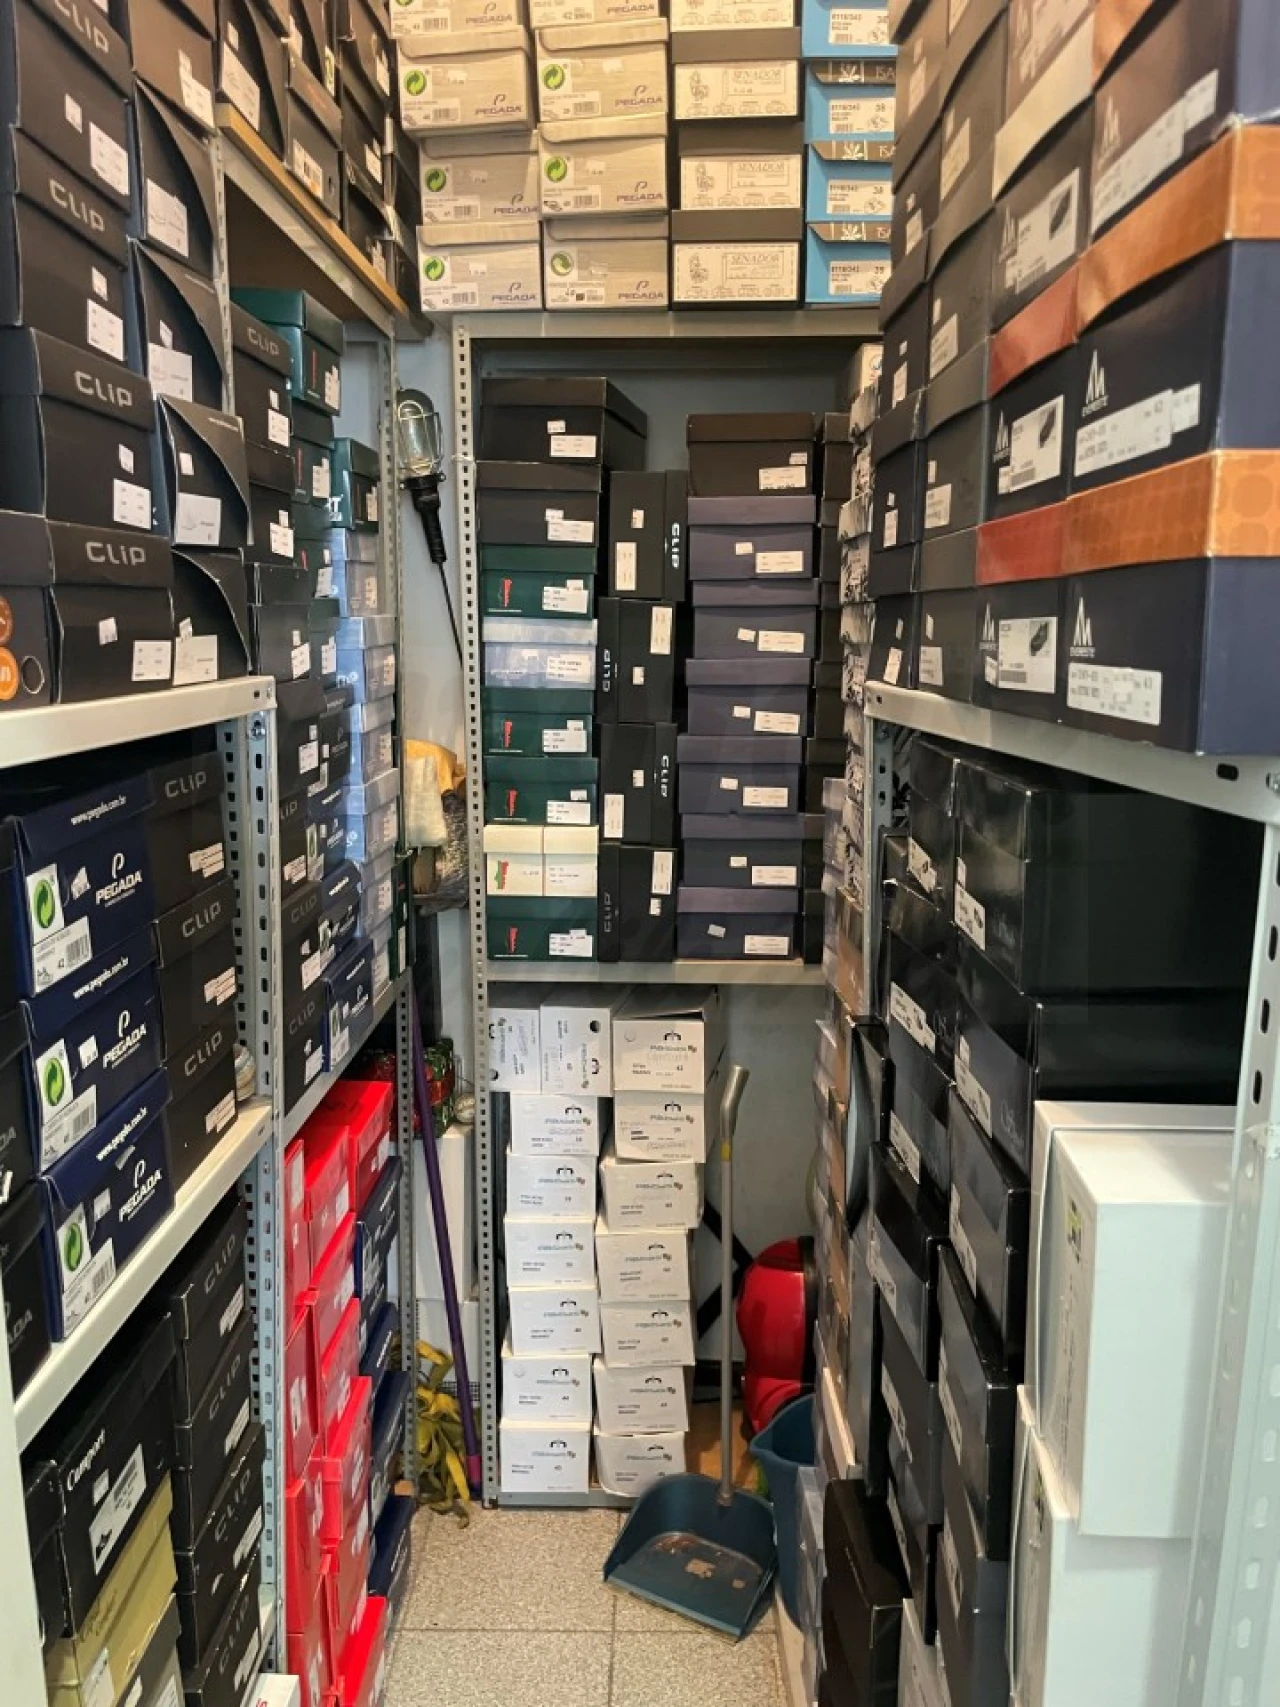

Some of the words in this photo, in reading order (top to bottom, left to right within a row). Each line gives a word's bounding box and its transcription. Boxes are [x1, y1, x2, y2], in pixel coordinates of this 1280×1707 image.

[465, 15, 513, 24] PEGADA
[607, 4, 655, 14] PEGADA
[475, 106, 522, 115] PEGADA
[615, 97, 662, 107] PEGADA
[50, 179, 105, 232] CLIP
[617, 193, 664, 202] PEGADA
[491, 293, 537, 302] PEGADA
[618, 292, 664, 300] PEGADA
[247, 326, 280, 357] CLIP
[74, 370, 133, 407] CLIP
[86, 541, 147, 566] CLIP
[671, 522, 680, 569] CLIP
[602, 648, 611, 693] CLIP
[165, 770, 208, 798] CLIP
[660, 754, 670, 797] CLIP
[96, 870, 143, 905] PEGADA
[181, 900, 222, 938] CLIP
[103, 1023, 147, 1070] PEGADA
[184, 1030, 223, 1077] CLIP
[119, 1169, 163, 1222] PEGADA
[204, 1234, 236, 1294] CLIP
